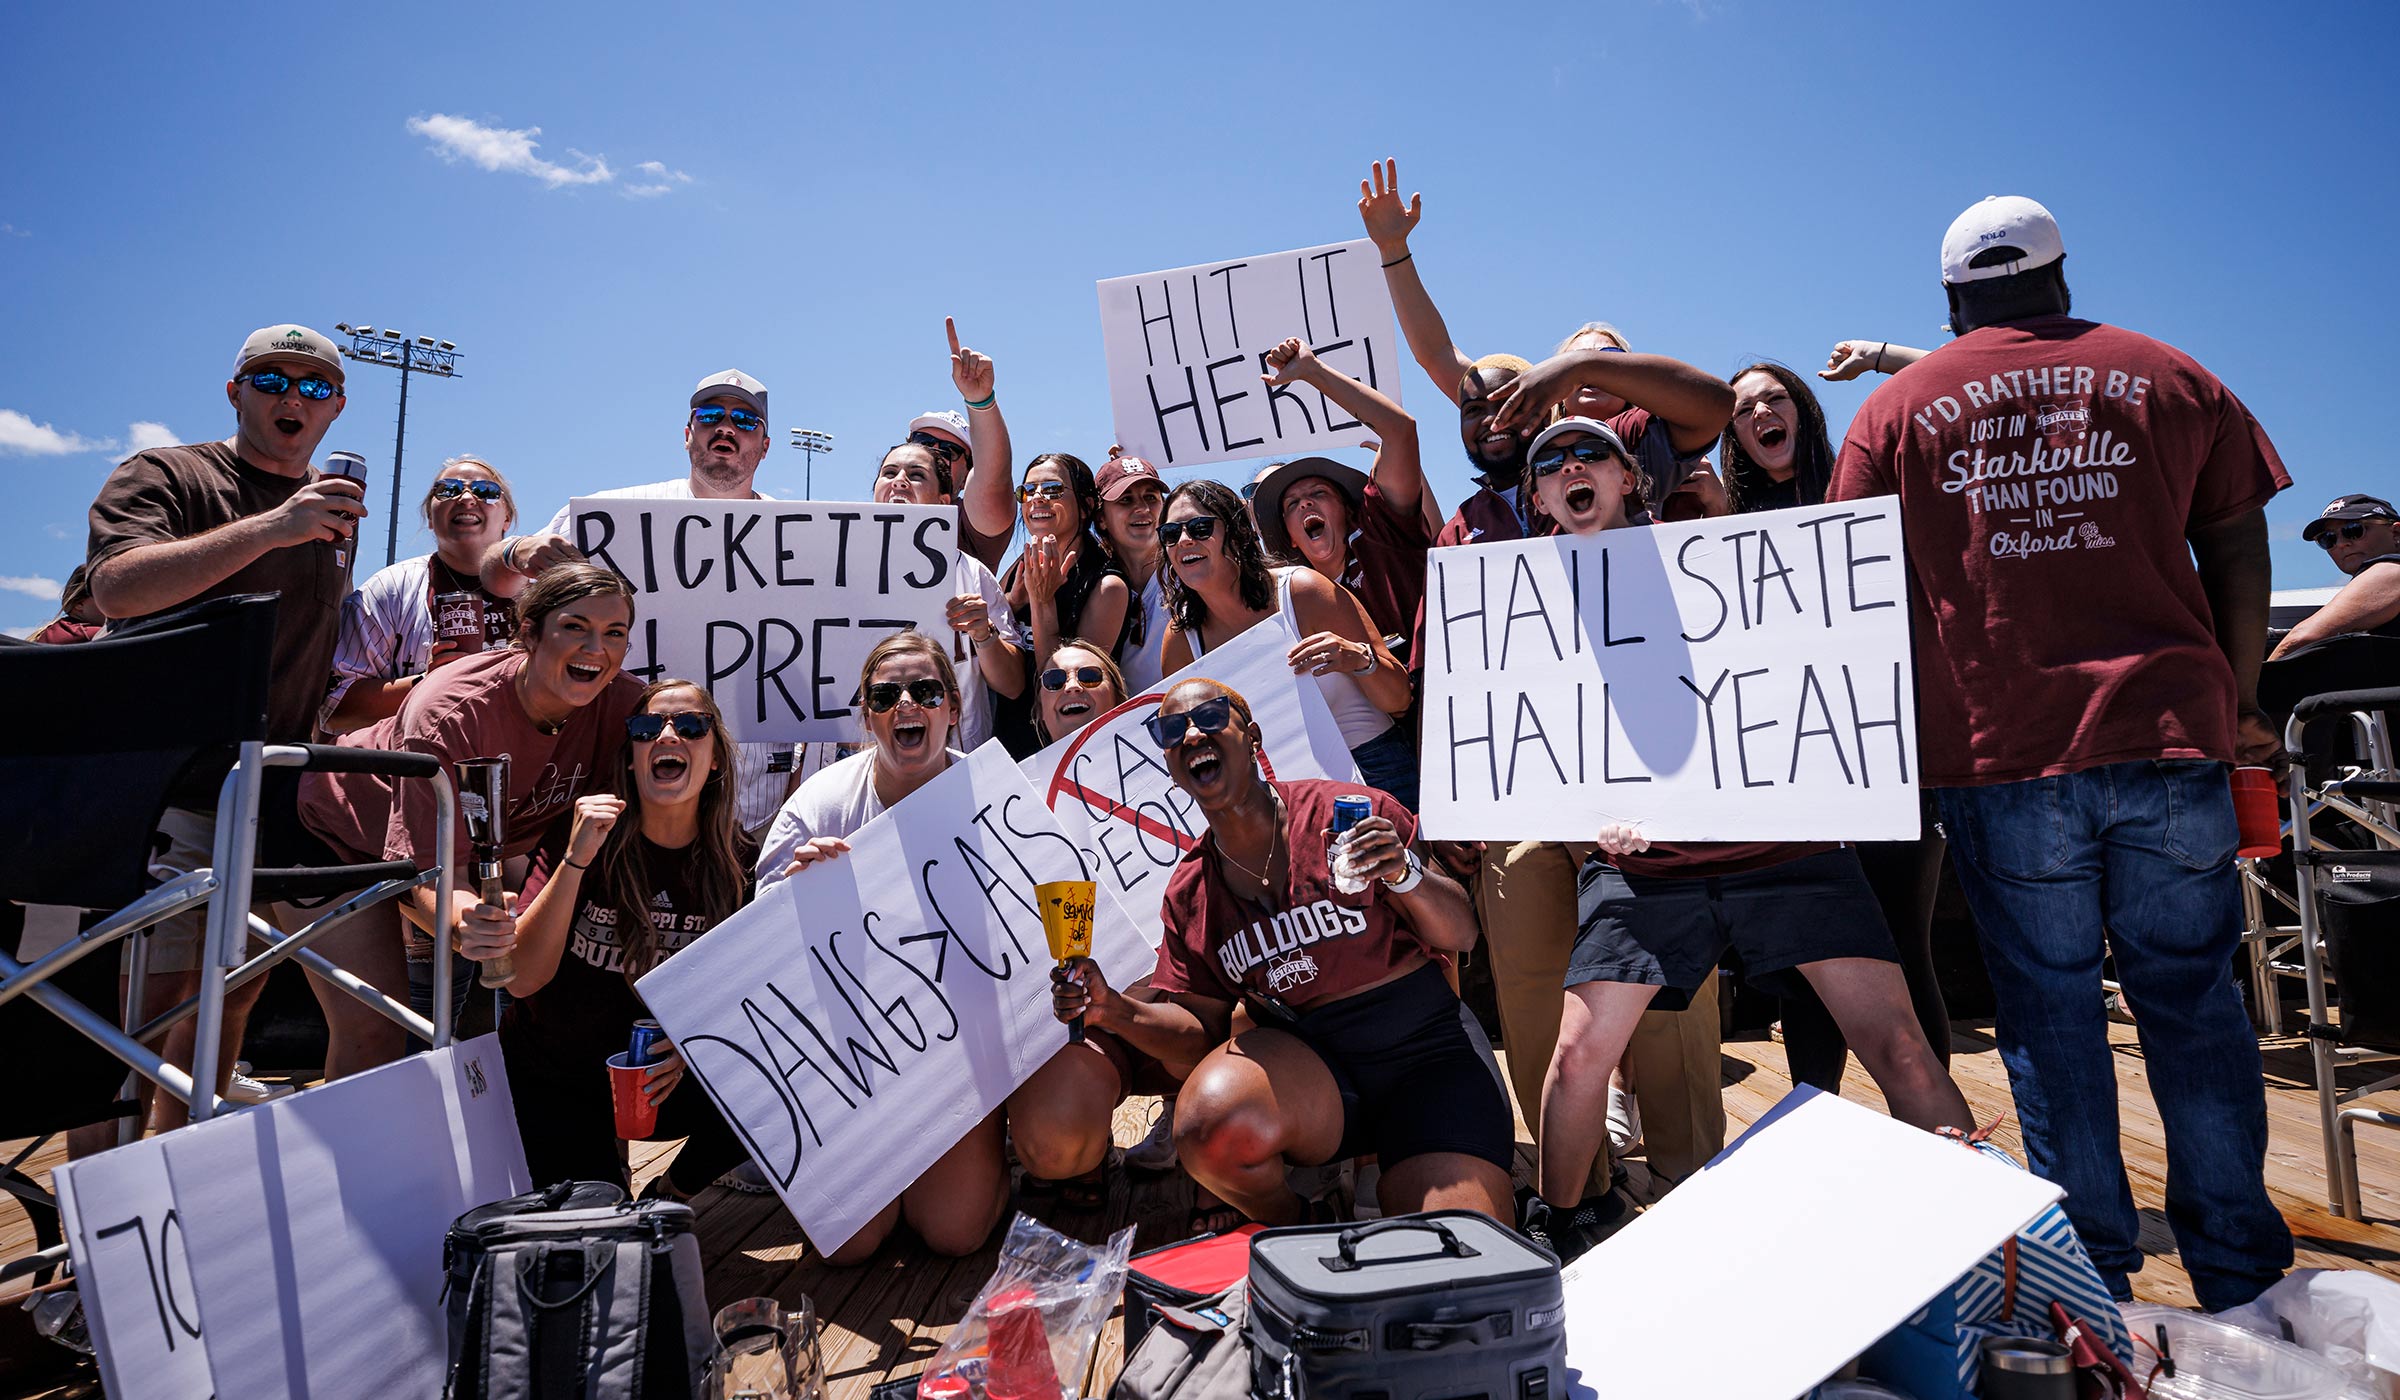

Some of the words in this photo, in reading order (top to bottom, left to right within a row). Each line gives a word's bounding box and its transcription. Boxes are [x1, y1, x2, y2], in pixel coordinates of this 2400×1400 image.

[1980, 230, 2006, 242] POLO
[1136, 263, 1247, 367] HIT
[1298, 249, 1347, 345] IT
[270, 341, 317, 353] MADISON
[1914, 395, 1962, 436] I'D
[1963, 366, 2095, 409] RATHER
[2103, 369, 2151, 406] BE
[1970, 416, 2004, 444] LOST
[2008, 414, 2027, 438] IN
[2043, 411, 2083, 427] STATE
[1942, 430, 2137, 494] Starkville
[1965, 481, 2030, 515] THAN
[2035, 472, 2119, 507] FOUND
[2035, 508, 2054, 529] IN
[2078, 521, 2099, 538] Ole
[576, 511, 951, 595] RICKETTS
[1989, 526, 2078, 560] Oxford
[2084, 533, 2116, 550] Miss
[1438, 547, 1646, 675] HAIL
[1678, 512, 1896, 643] STATE
[444, 611, 470, 620] STATE
[440, 626, 480, 637] SOFTBALL
[1449, 682, 1652, 802] HAIL
[1678, 662, 1908, 790] YEAH
[1217, 899, 1368, 985] BULLDOGS
[1274, 960, 1309, 980] STATE
